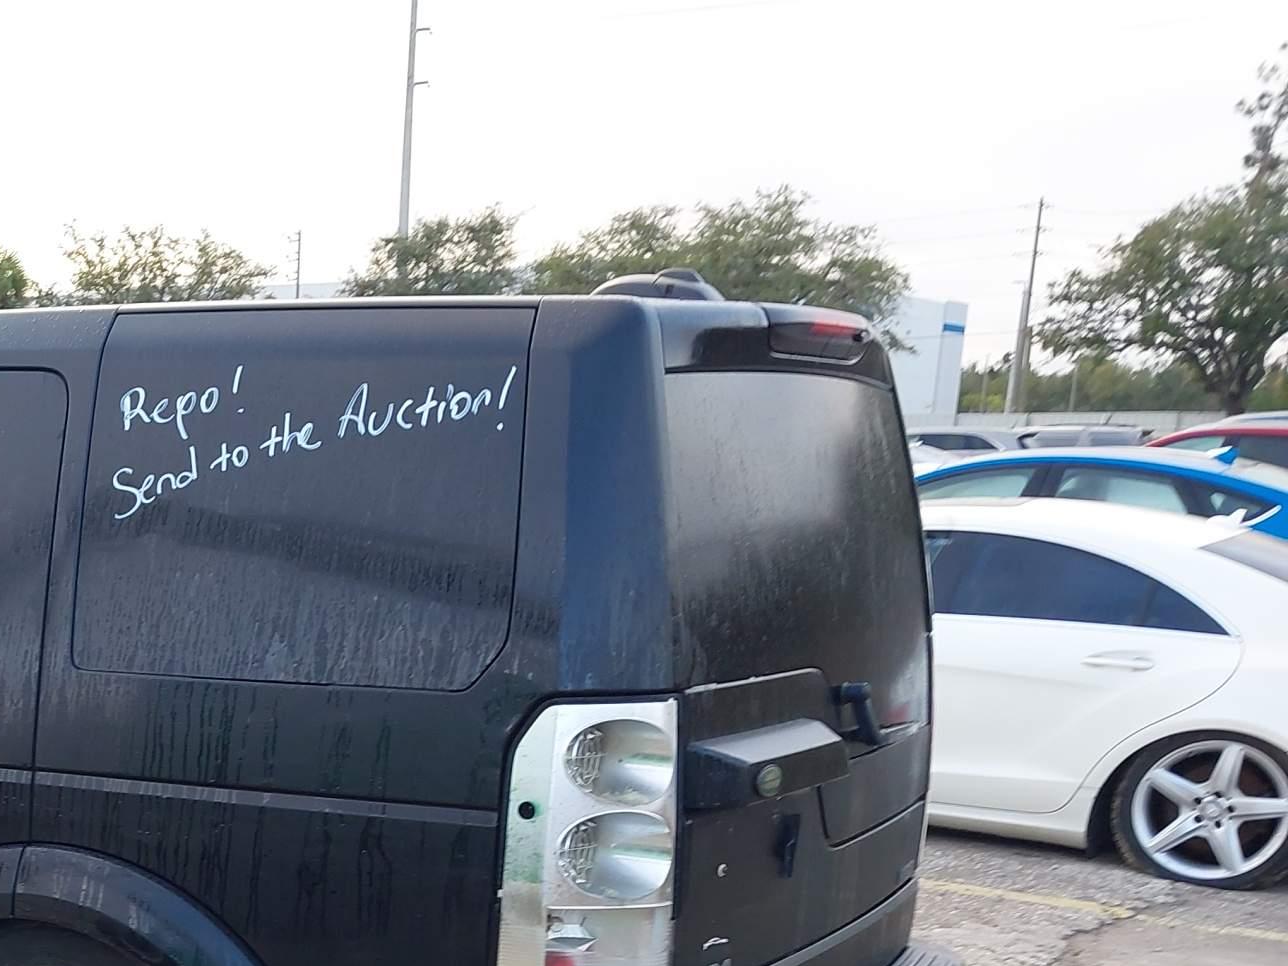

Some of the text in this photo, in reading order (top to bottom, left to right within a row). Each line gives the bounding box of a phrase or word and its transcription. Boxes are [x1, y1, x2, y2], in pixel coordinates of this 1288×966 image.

[112, 365, 518, 520] Send to the Auction!
[120, 365, 244, 440] Repo!
